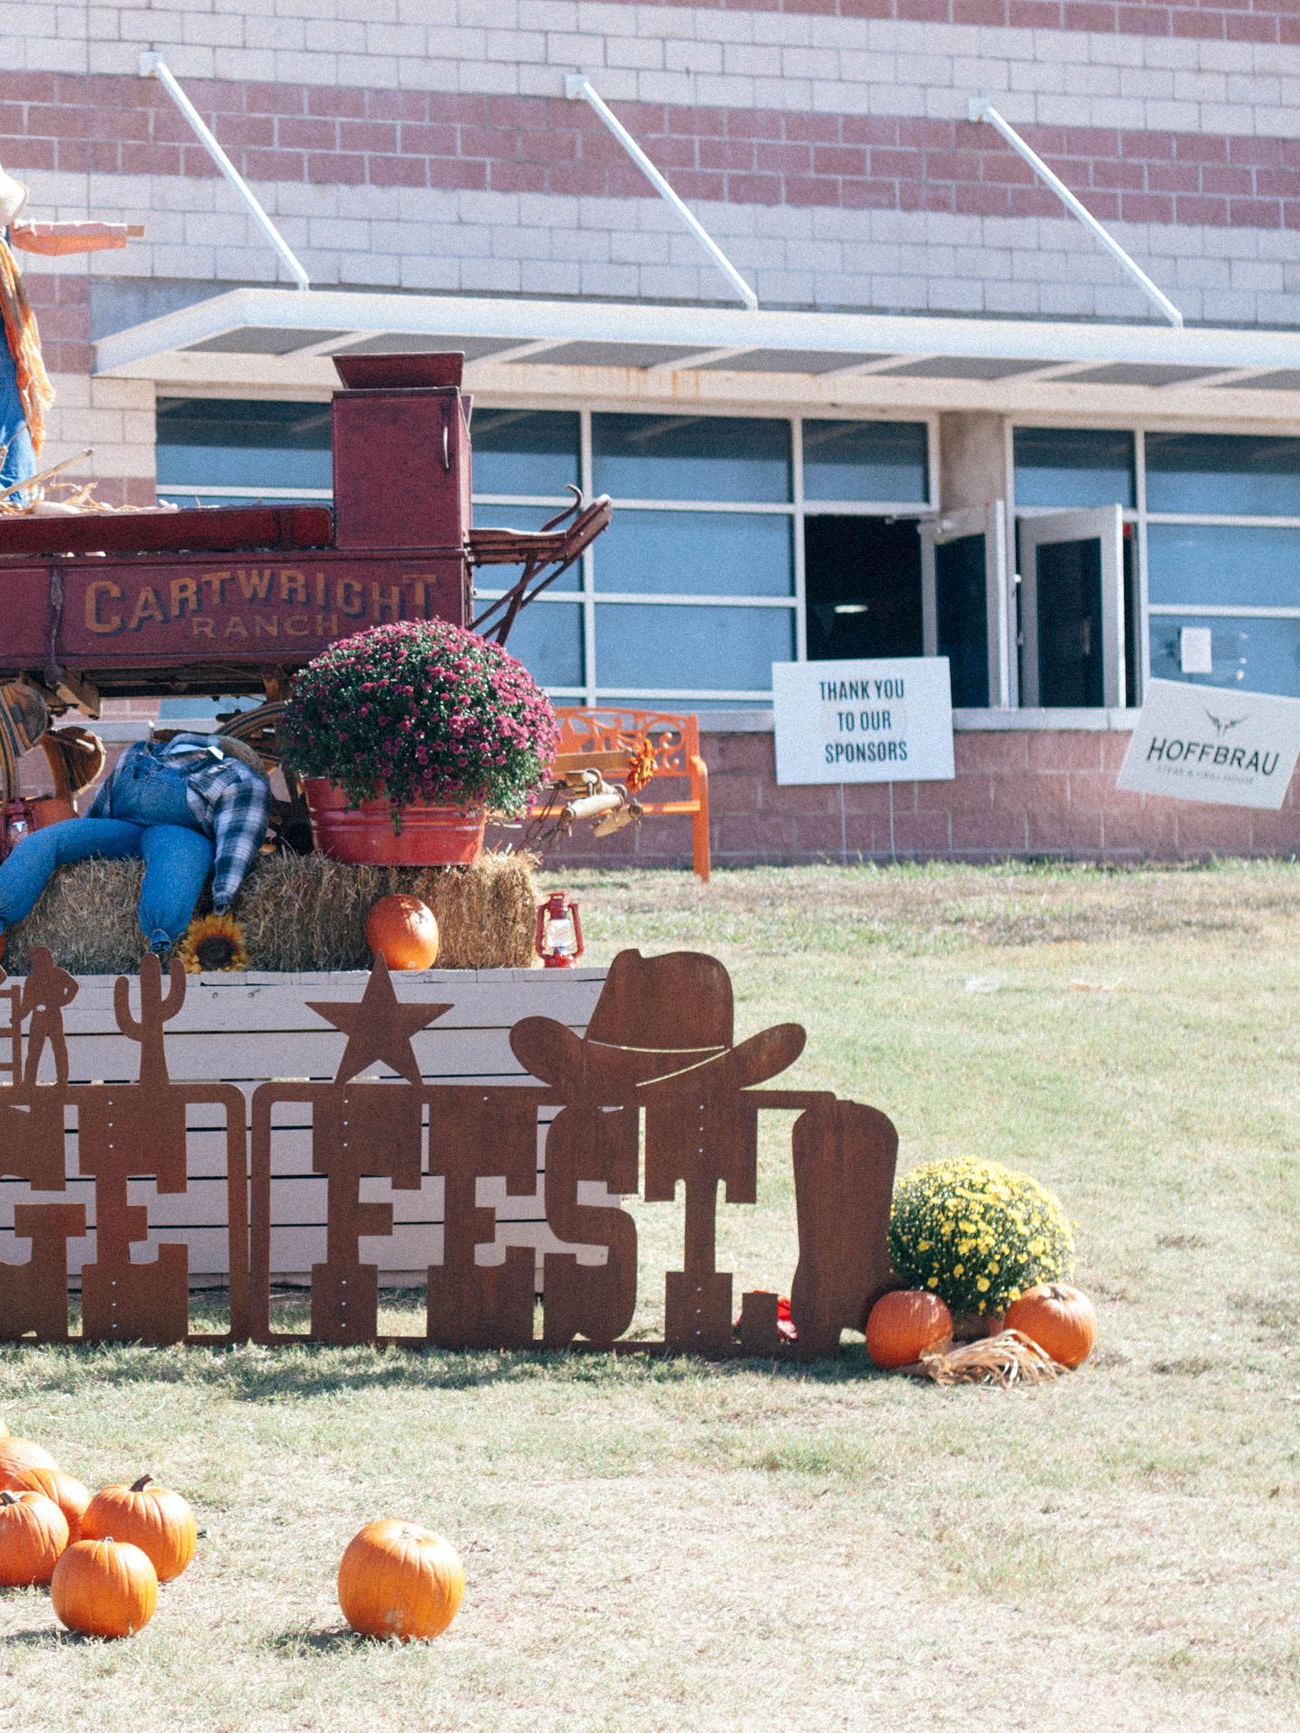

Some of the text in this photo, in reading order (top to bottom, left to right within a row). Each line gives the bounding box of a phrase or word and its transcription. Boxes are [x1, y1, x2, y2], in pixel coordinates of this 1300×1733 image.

[84, 569, 438, 635] CARTWRIGHT
[190, 614, 339, 639] RANCH
[819, 679, 905, 701] THANK YOU
[837, 711, 892, 732] TO OUR
[825, 741, 908, 764] SPONSORS
[1147, 736, 1280, 777] HOFFBRAU
[310, 1098, 759, 1350] FEST
